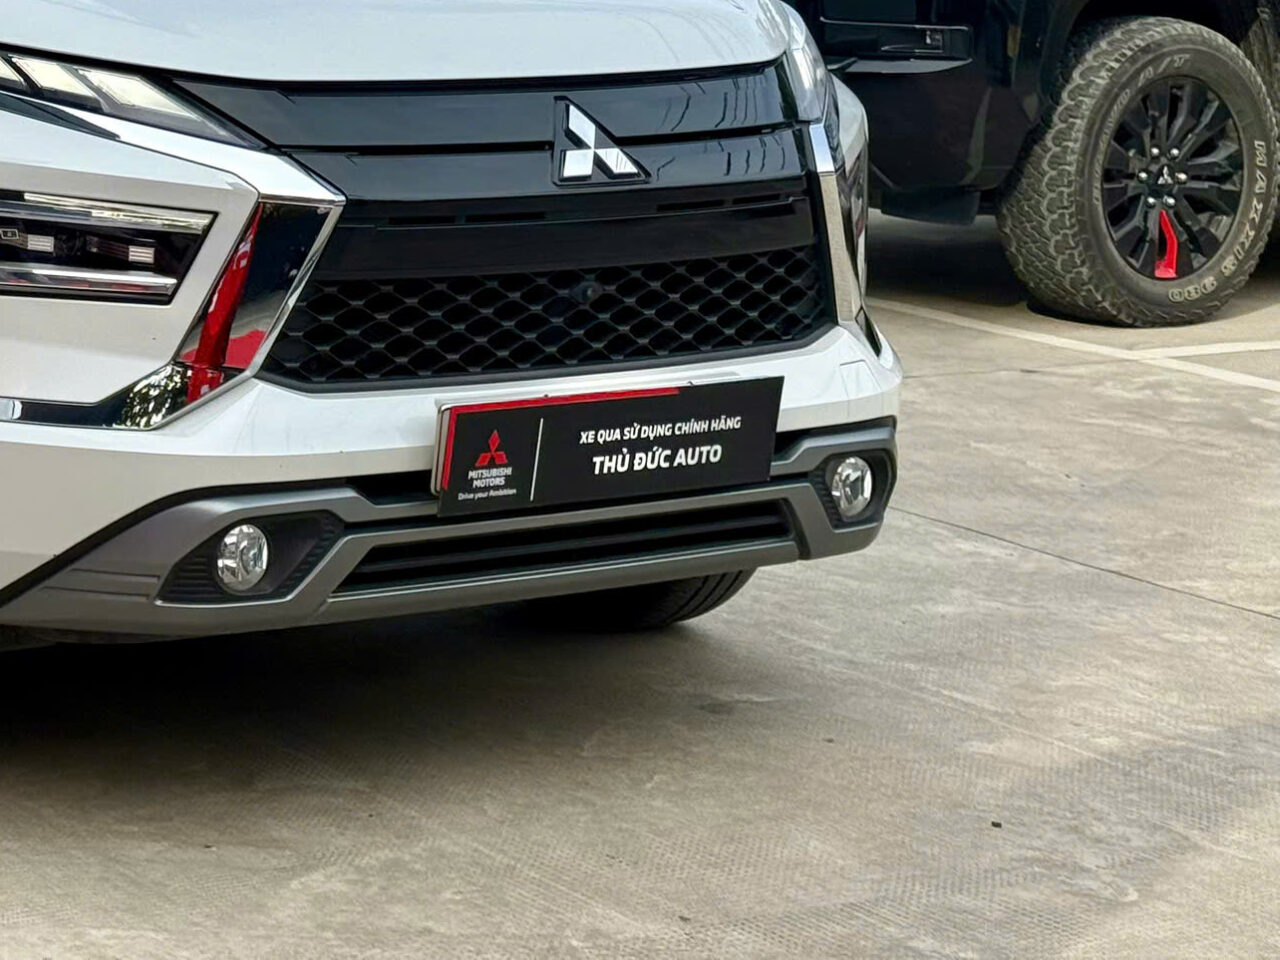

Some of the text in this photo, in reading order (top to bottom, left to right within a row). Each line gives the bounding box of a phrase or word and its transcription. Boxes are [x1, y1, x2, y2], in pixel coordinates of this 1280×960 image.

[1168, 140, 1268, 303] MAXXIS 980
[579, 414, 742, 445] XE QUA SỬ DỤNG CHÍNH HÃNG
[592, 444, 722, 475] THỦ ĐỨC AUTO
[468, 466, 512, 480] MITSUBISHI
[473, 477, 506, 488] MOTORS
[458, 488, 517, 501] Drive your Ambition
